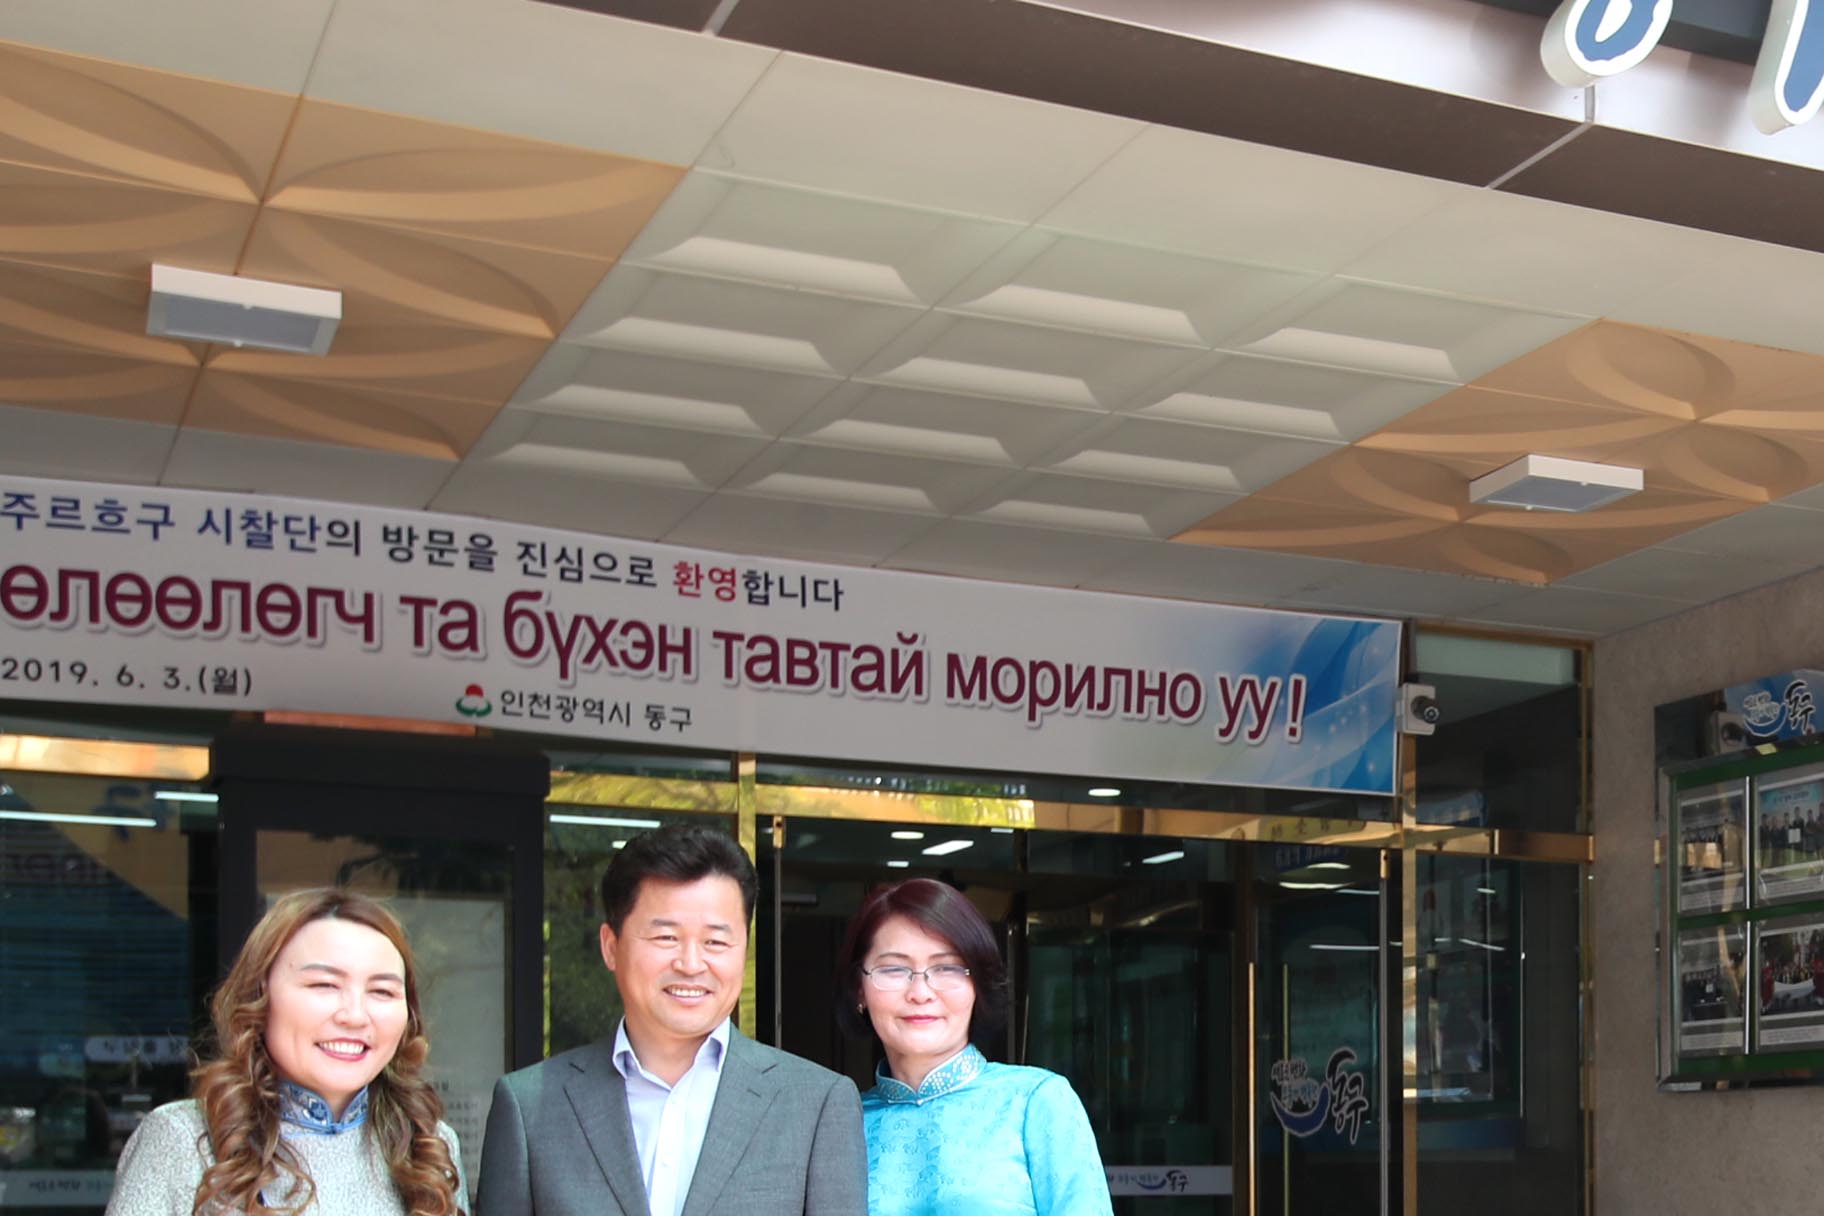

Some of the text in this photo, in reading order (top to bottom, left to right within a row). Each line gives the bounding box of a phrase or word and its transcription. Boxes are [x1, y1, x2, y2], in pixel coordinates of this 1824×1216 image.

[0, 491, 845, 611] 주르흐구 시찰단의 방문을 진심으로 환영합니다
[0, 564, 375, 643] өлөөлөгч
[399, 593, 481, 653] та
[503, 589, 693, 681] бүхэн
[712, 631, 924, 696] тавтай
[946, 652, 1203, 722] морилно
[1, 657, 99, 687] 2019.
[115, 665, 146, 689] 6.
[500, 689, 693, 733] 인천광역시 동구
